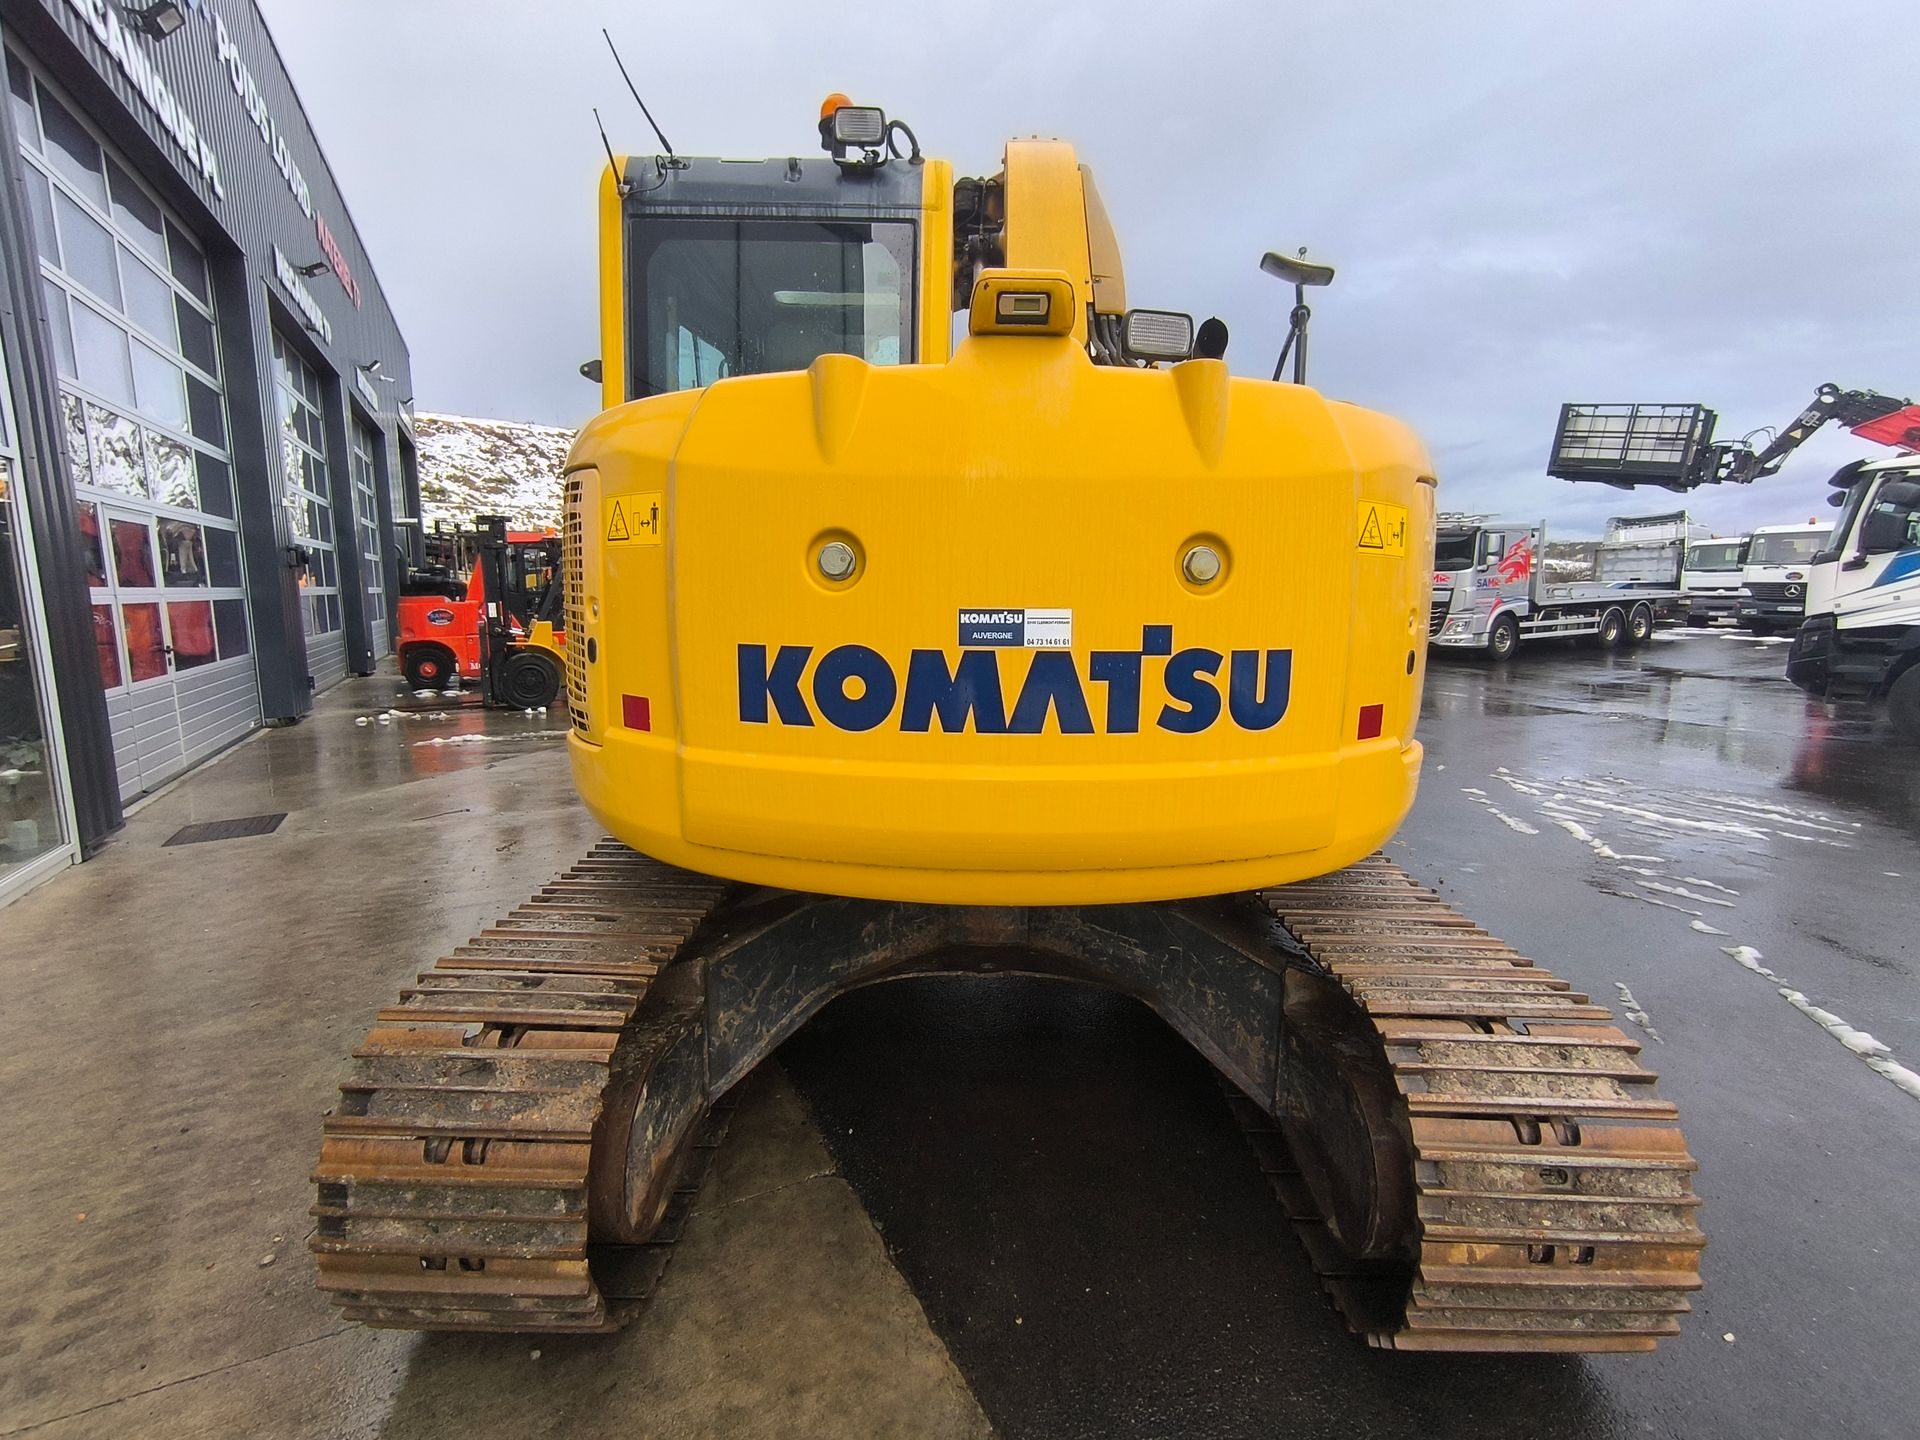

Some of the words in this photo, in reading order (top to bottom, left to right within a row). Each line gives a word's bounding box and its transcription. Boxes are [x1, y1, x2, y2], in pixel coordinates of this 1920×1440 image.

[213, 12, 270, 144] POIDS
[270, 117, 311, 219] LOURD
[960, 611, 1023, 624] KOMATSU
[972, 631, 1013, 639] AUVERGNE
[738, 625, 1293, 734] KOMATSU
